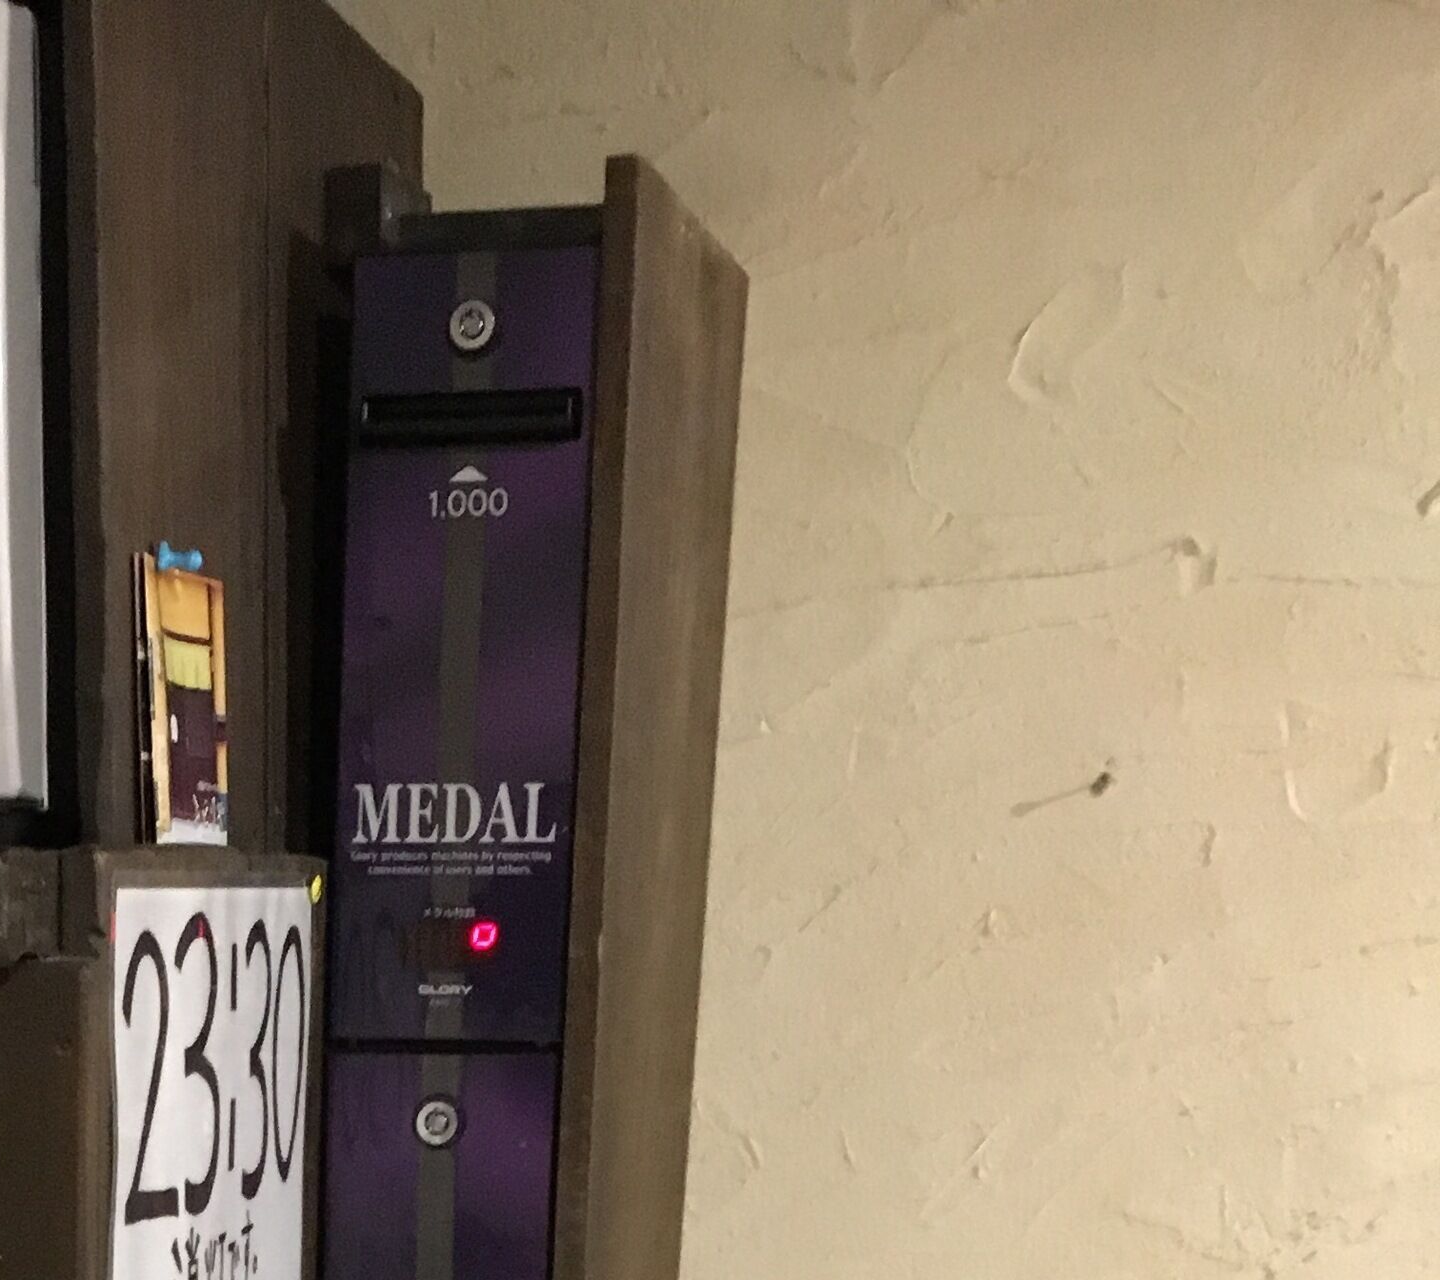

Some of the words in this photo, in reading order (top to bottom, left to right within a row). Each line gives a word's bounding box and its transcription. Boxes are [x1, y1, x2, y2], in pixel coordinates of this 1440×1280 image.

[352, 781, 557, 844] MEDAL
[418, 984, 473, 995] GLORY
[122, 911, 306, 1226] 23:30
